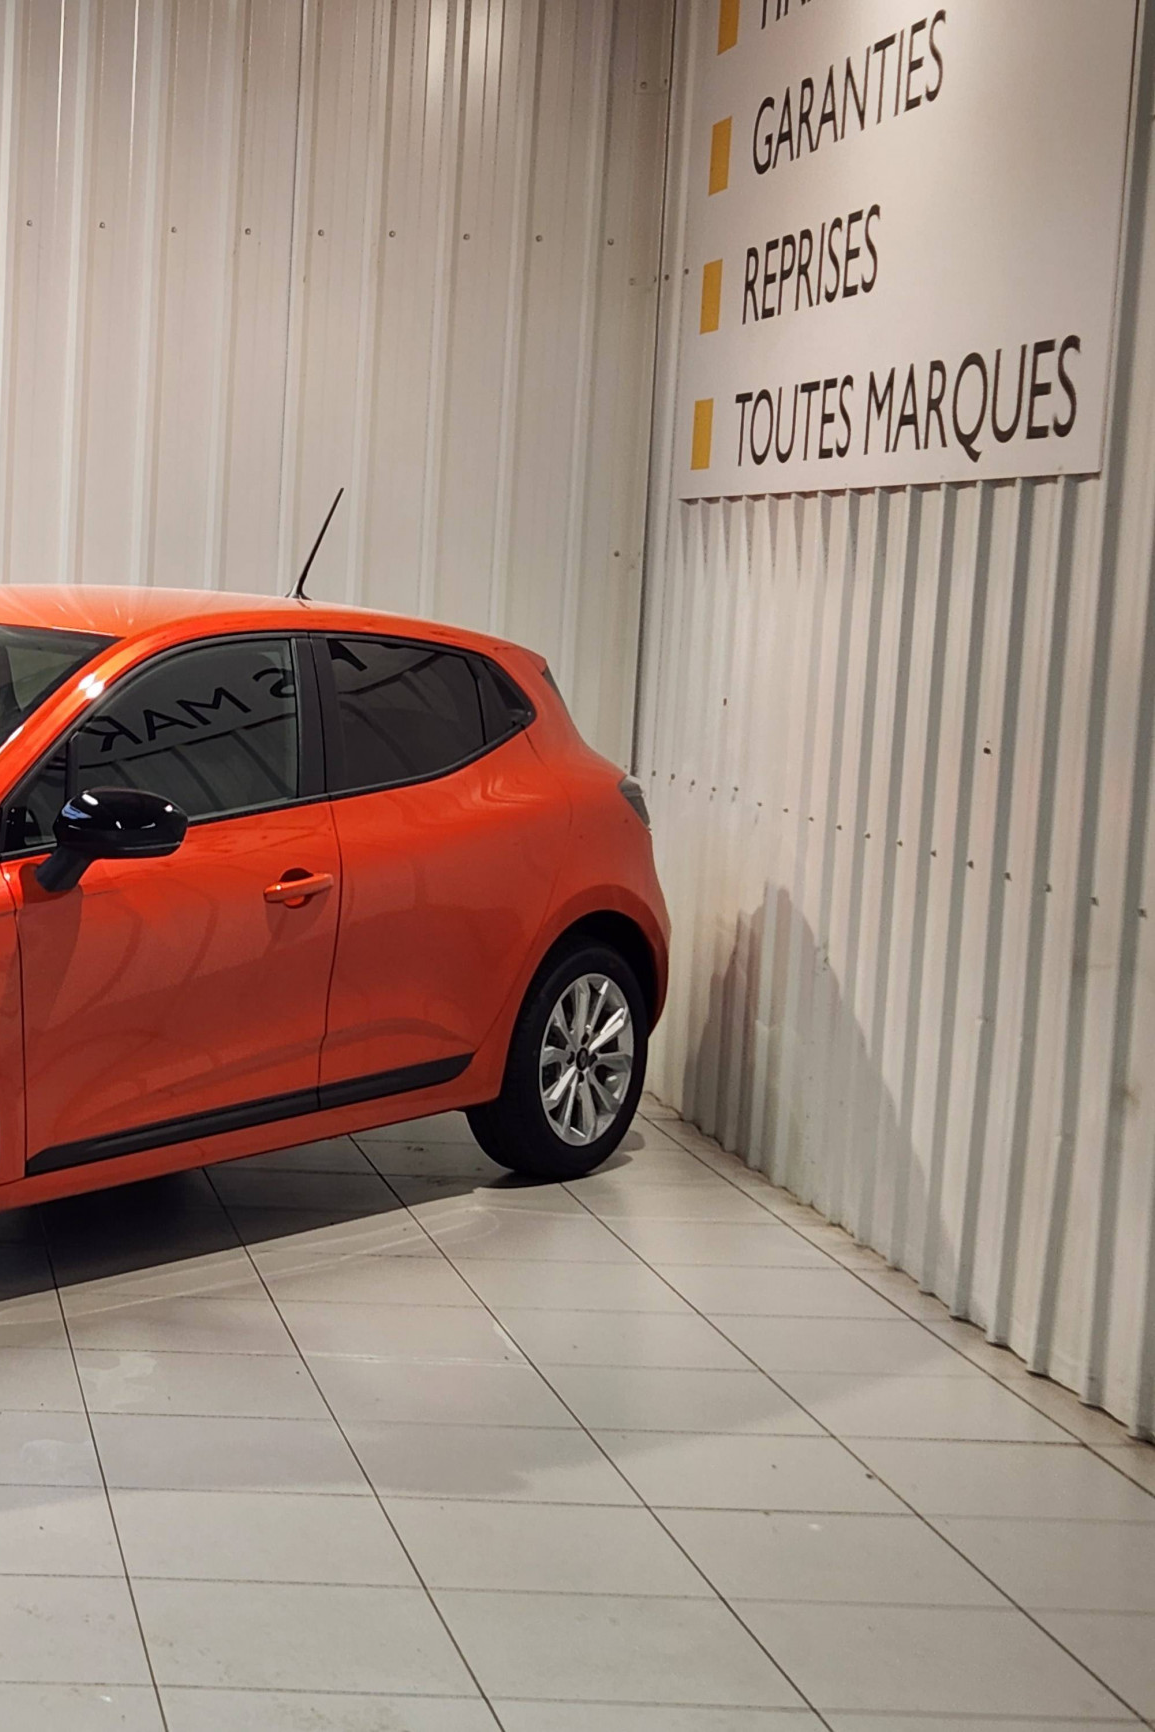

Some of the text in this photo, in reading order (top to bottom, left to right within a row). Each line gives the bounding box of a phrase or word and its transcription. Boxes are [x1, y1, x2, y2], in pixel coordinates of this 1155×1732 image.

[752, 9, 947, 175] GARANTIES
[742, 204, 881, 326] REPRISES
[735, 335, 1081, 467] TOUTES MARQUES
